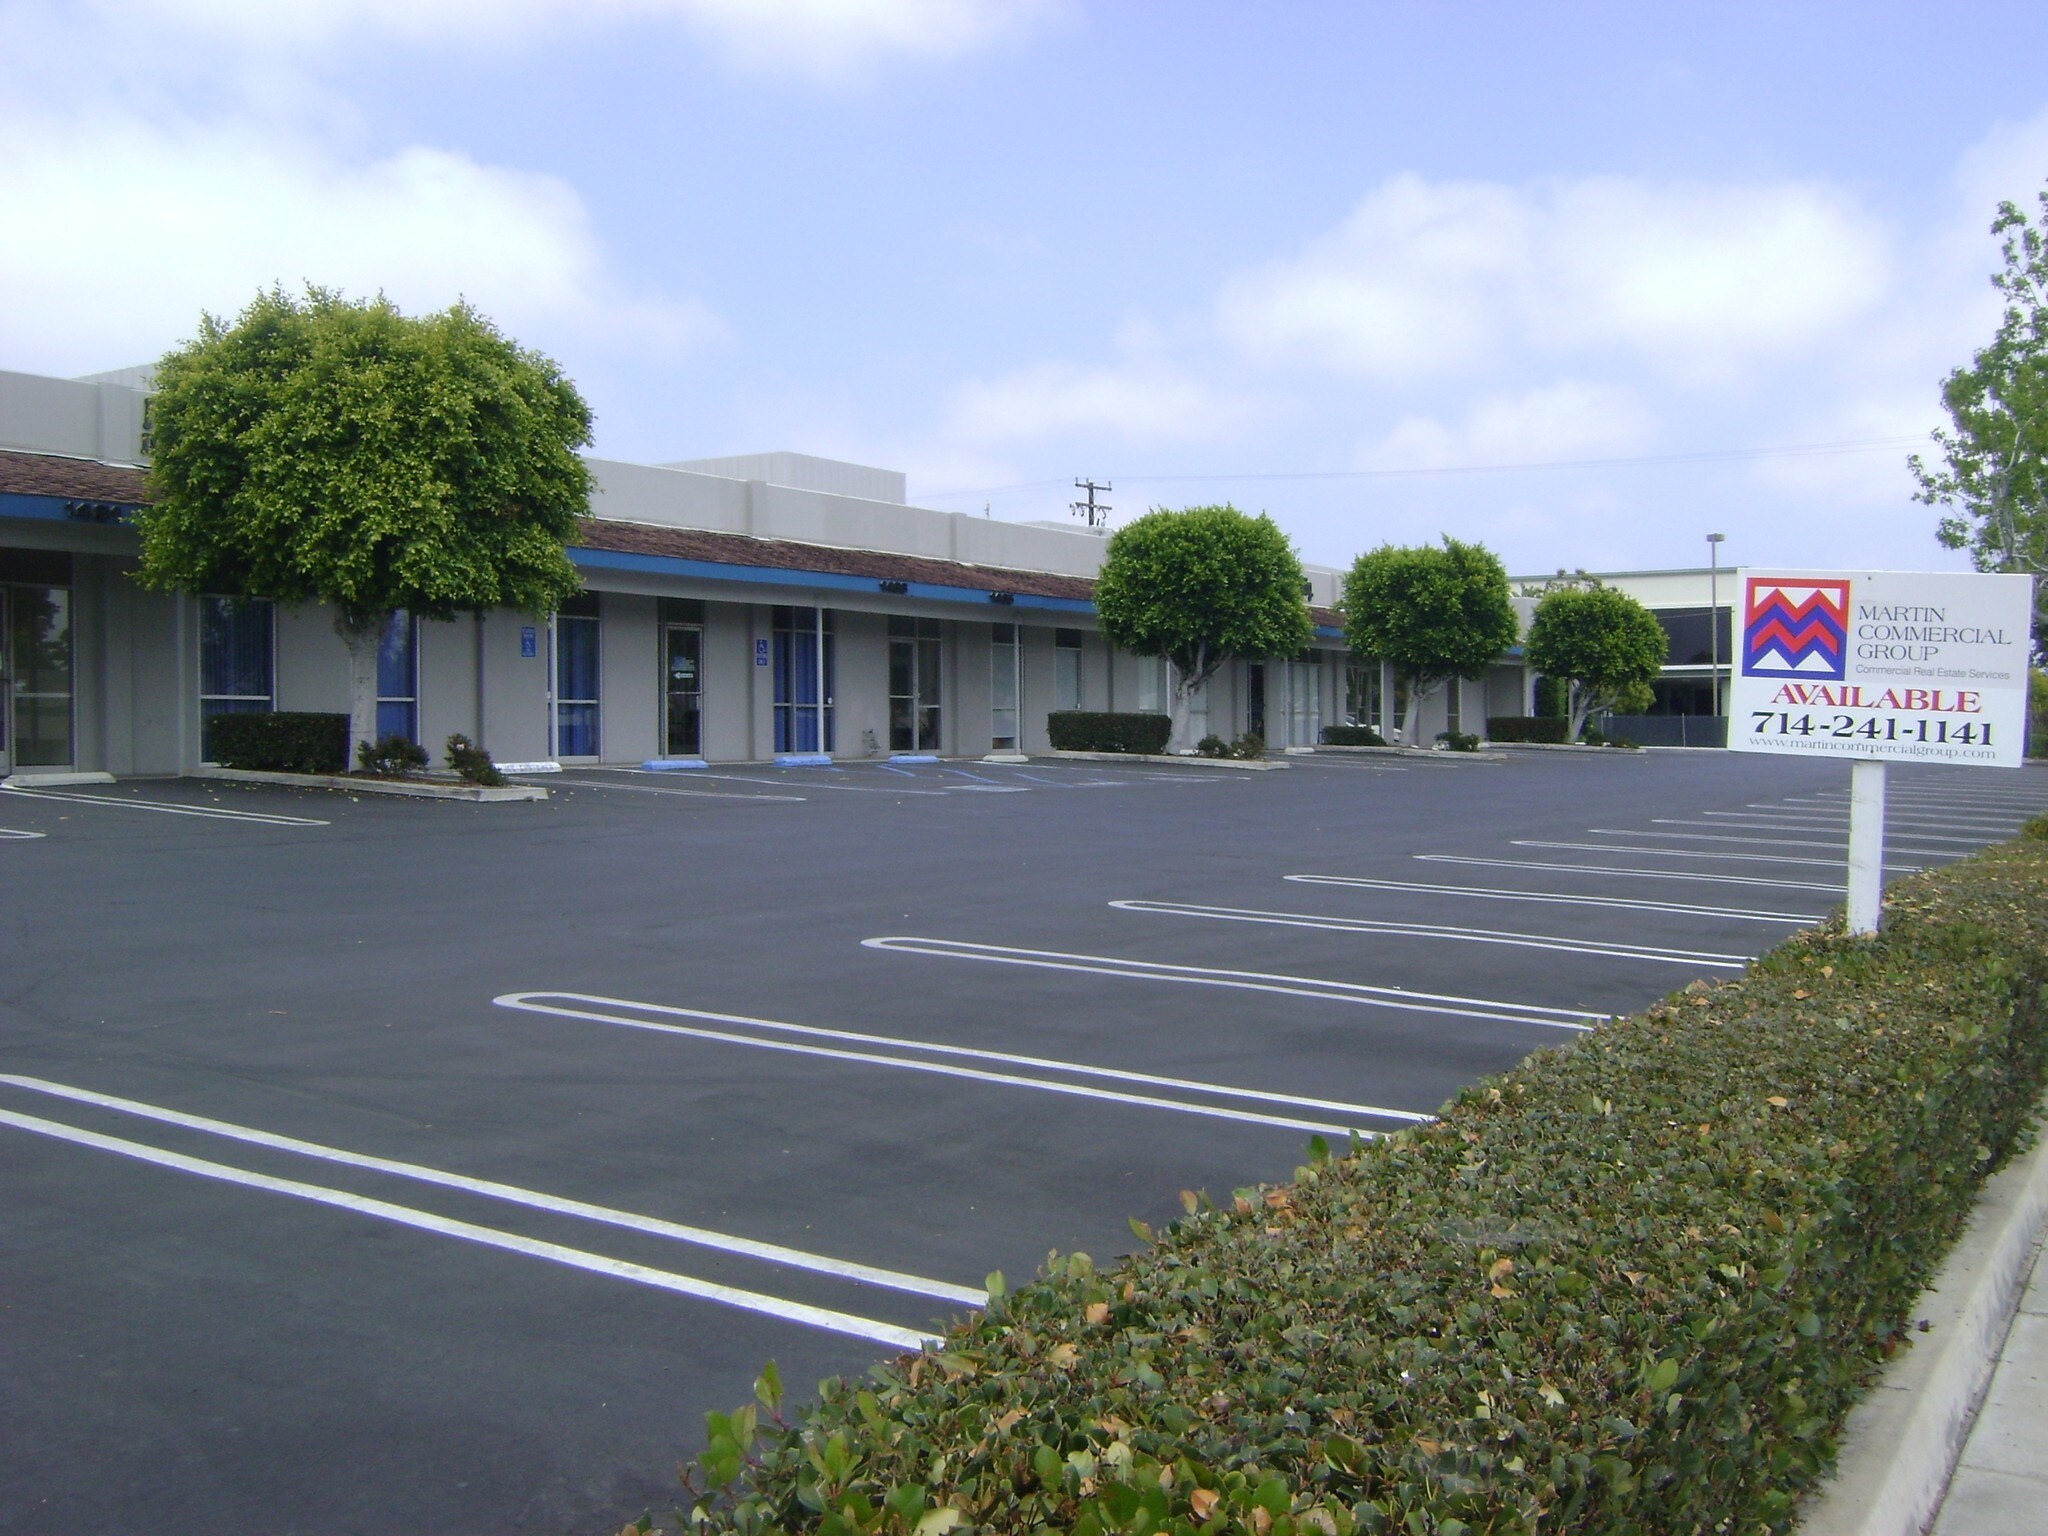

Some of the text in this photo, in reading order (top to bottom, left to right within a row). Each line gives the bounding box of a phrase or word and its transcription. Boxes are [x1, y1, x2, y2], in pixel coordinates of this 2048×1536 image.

[1858, 605, 1946, 622] MARTIN
[1858, 625, 2012, 645] COMMERCIAL
[1857, 644, 1939, 662] GROUP
[1856, 664, 2010, 680] Commercial Real Estate Services
[1771, 683, 1982, 713] AVAILABLE
[1751, 711, 1994, 746] 714-241-1141
[1749, 737, 1996, 760] www.martincommercialgroup.com
